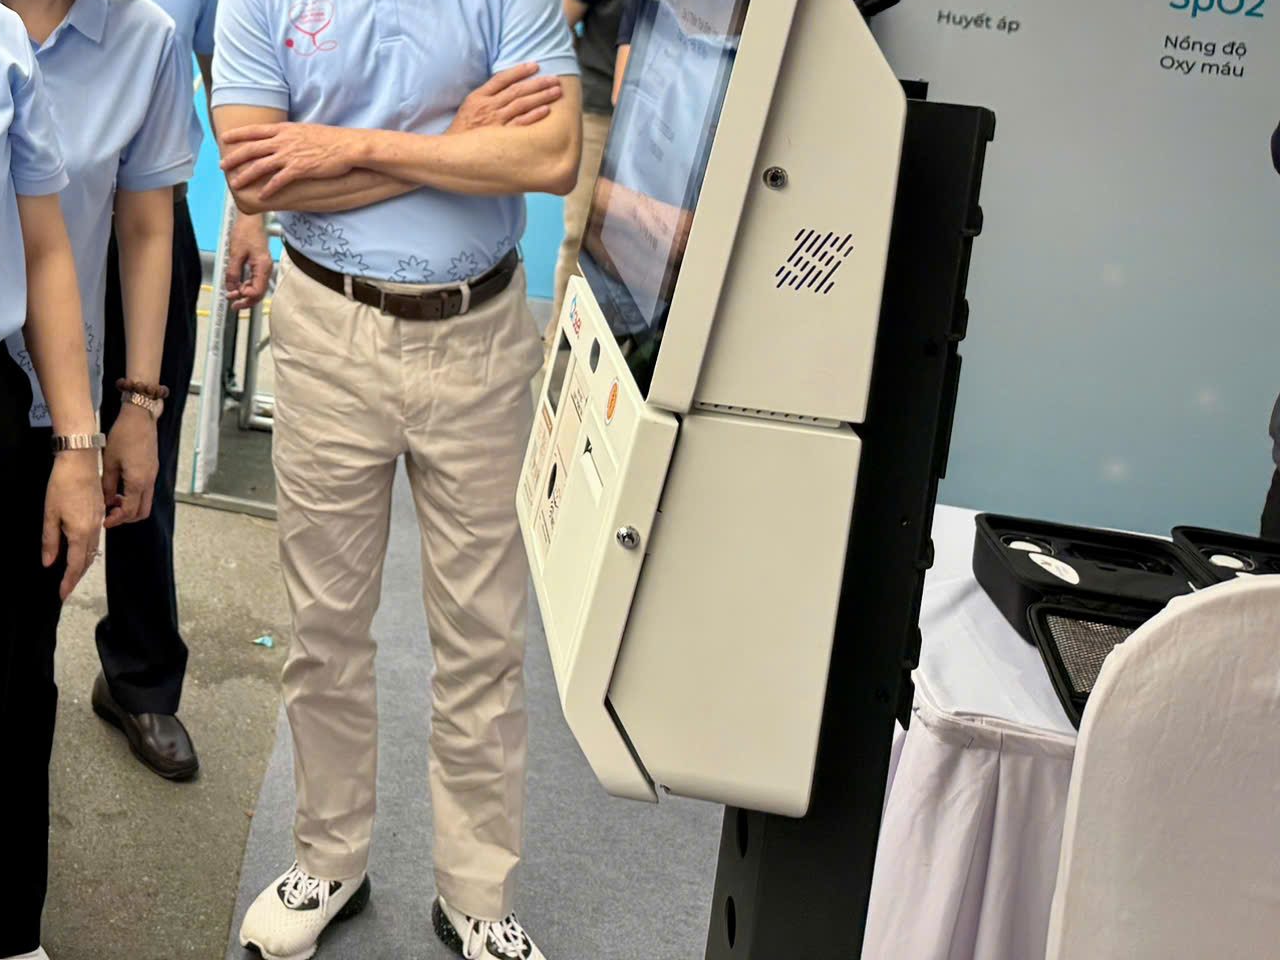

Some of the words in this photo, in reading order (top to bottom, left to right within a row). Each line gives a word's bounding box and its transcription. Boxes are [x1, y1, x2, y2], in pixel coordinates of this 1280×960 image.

[937, 10, 991, 30] Huyết
[996, 16, 1020, 35] áp
[1222, 41, 1247, 61] độ
[1160, 55, 1196, 76] Oxy
[1201, 61, 1244, 78] máu
